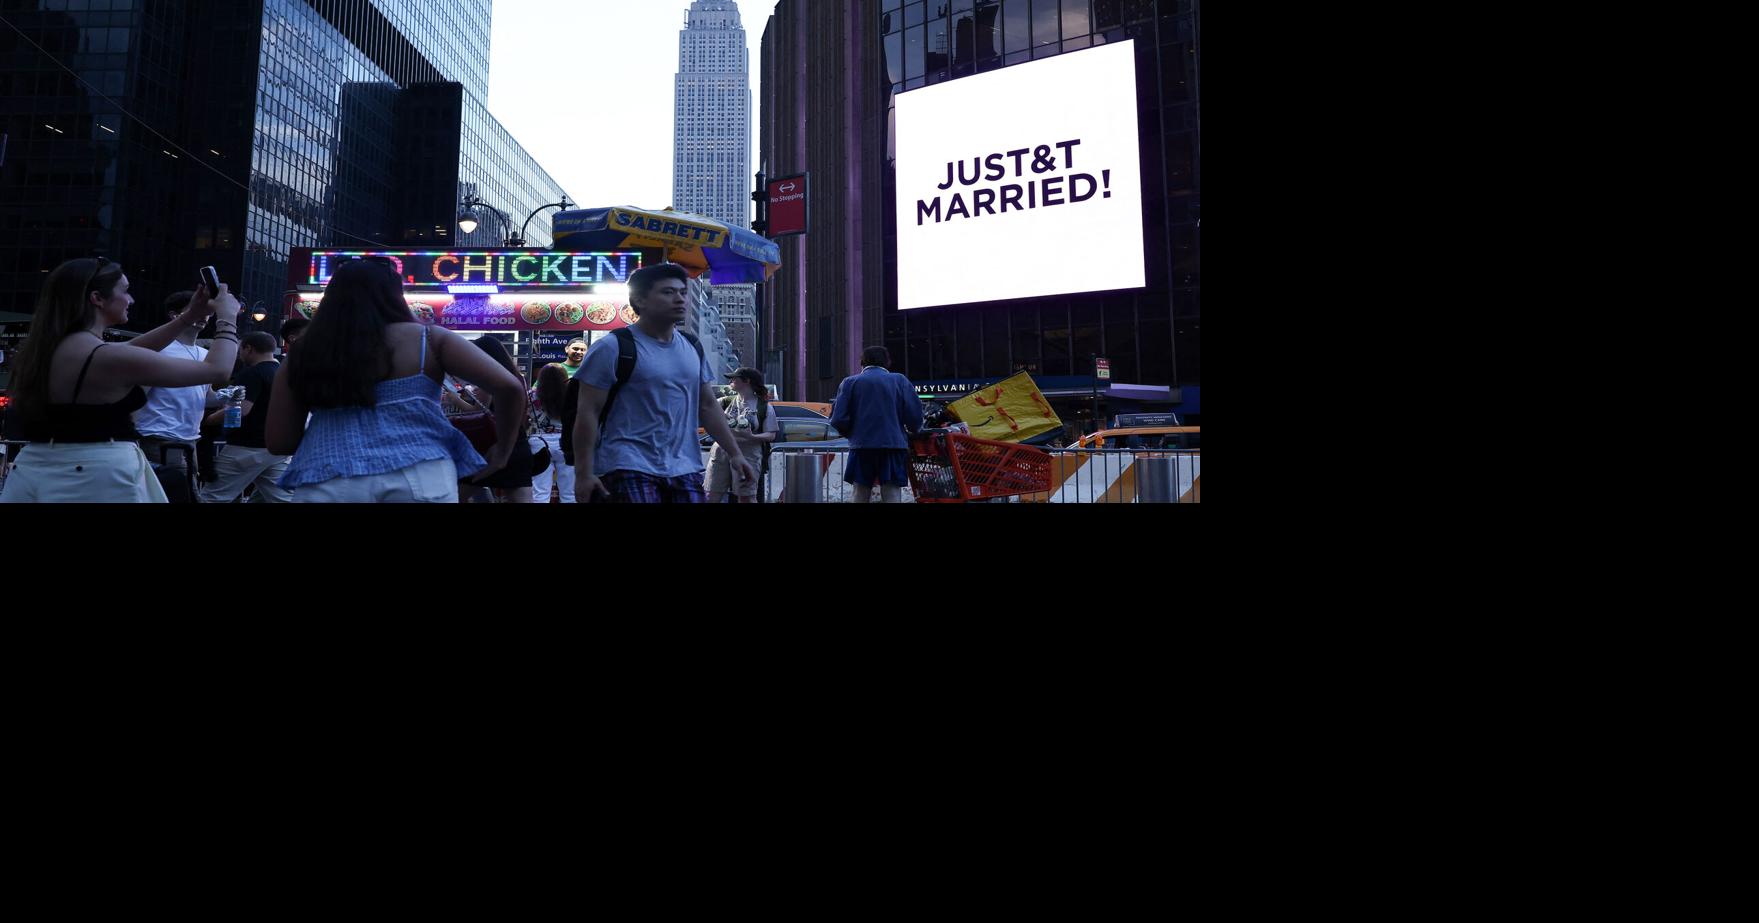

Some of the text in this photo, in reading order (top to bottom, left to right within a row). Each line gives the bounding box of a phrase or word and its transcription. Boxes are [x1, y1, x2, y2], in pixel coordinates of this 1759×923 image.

[937, 138, 1081, 190] JUST&T
[779, 192, 804, 201] Stopping
[917, 169, 1111, 226] MARRIED!
[615, 212, 721, 242] SABRETT
[432, 255, 627, 282] CHICKEN
[441, 317, 516, 325] HALAL FOOD
